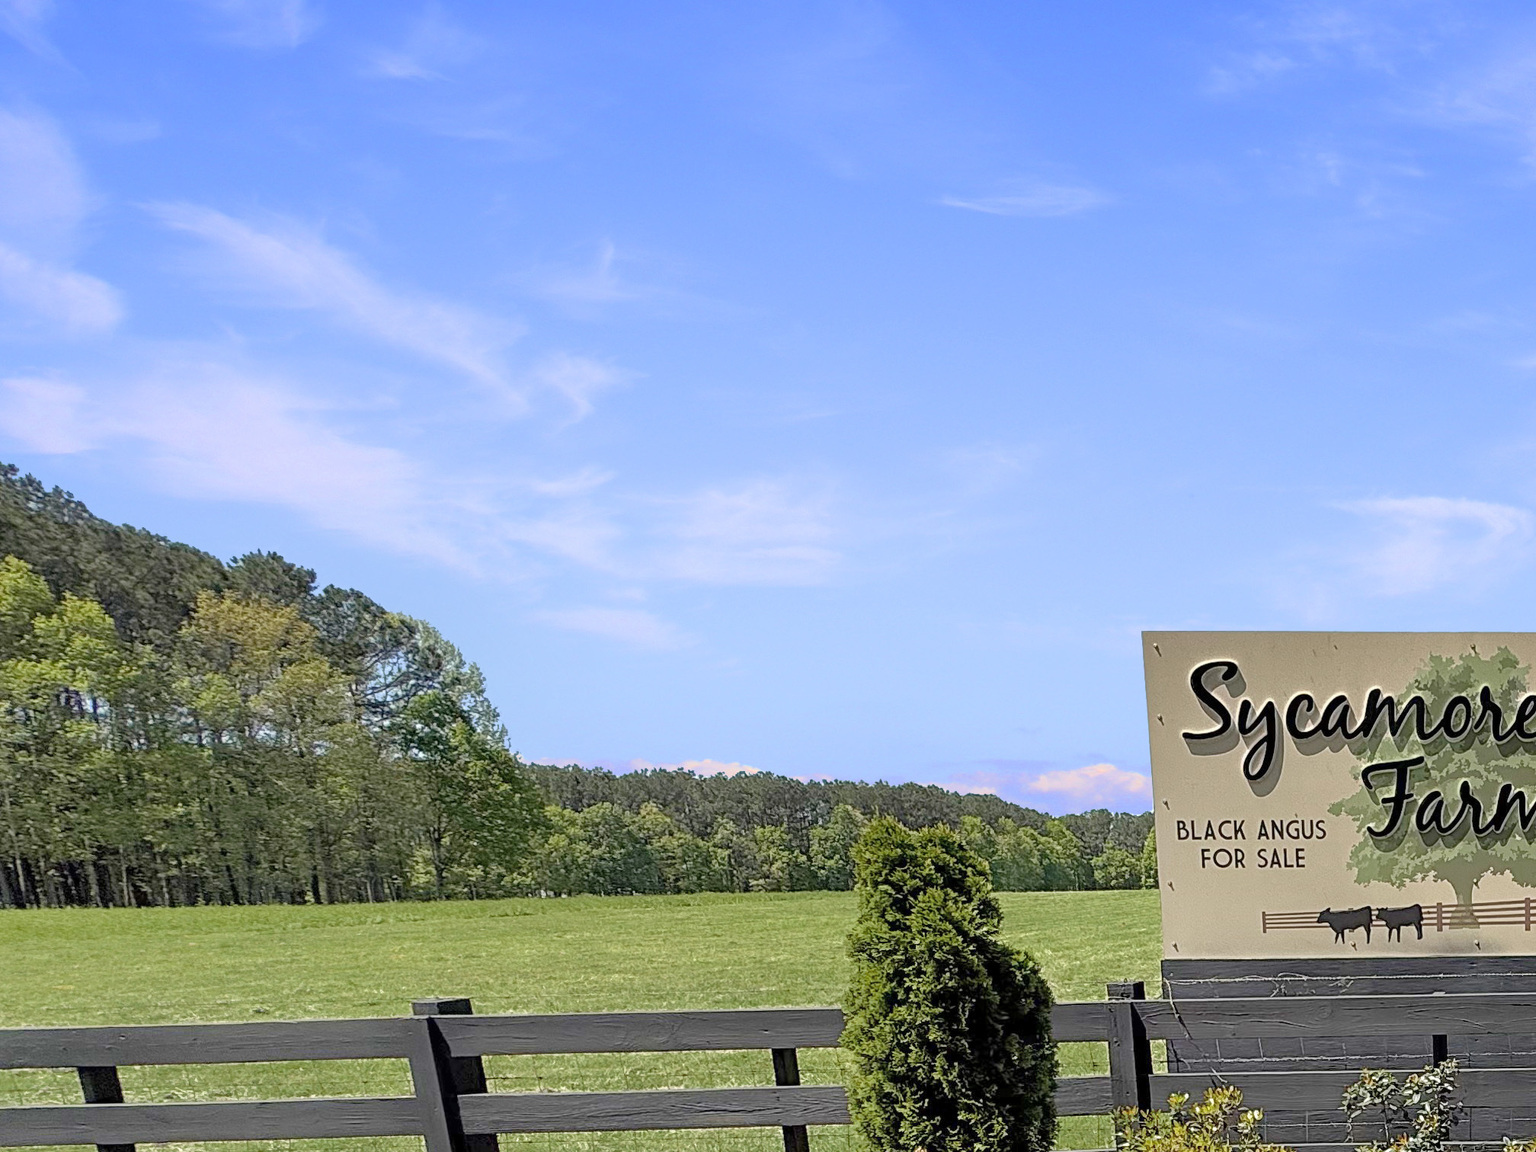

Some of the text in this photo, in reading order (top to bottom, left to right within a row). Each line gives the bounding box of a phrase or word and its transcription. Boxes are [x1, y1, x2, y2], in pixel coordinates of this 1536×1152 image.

[1176, 819, 1327, 841] BLACK ANGUS
[1200, 848, 1306, 869] FOR SALE
